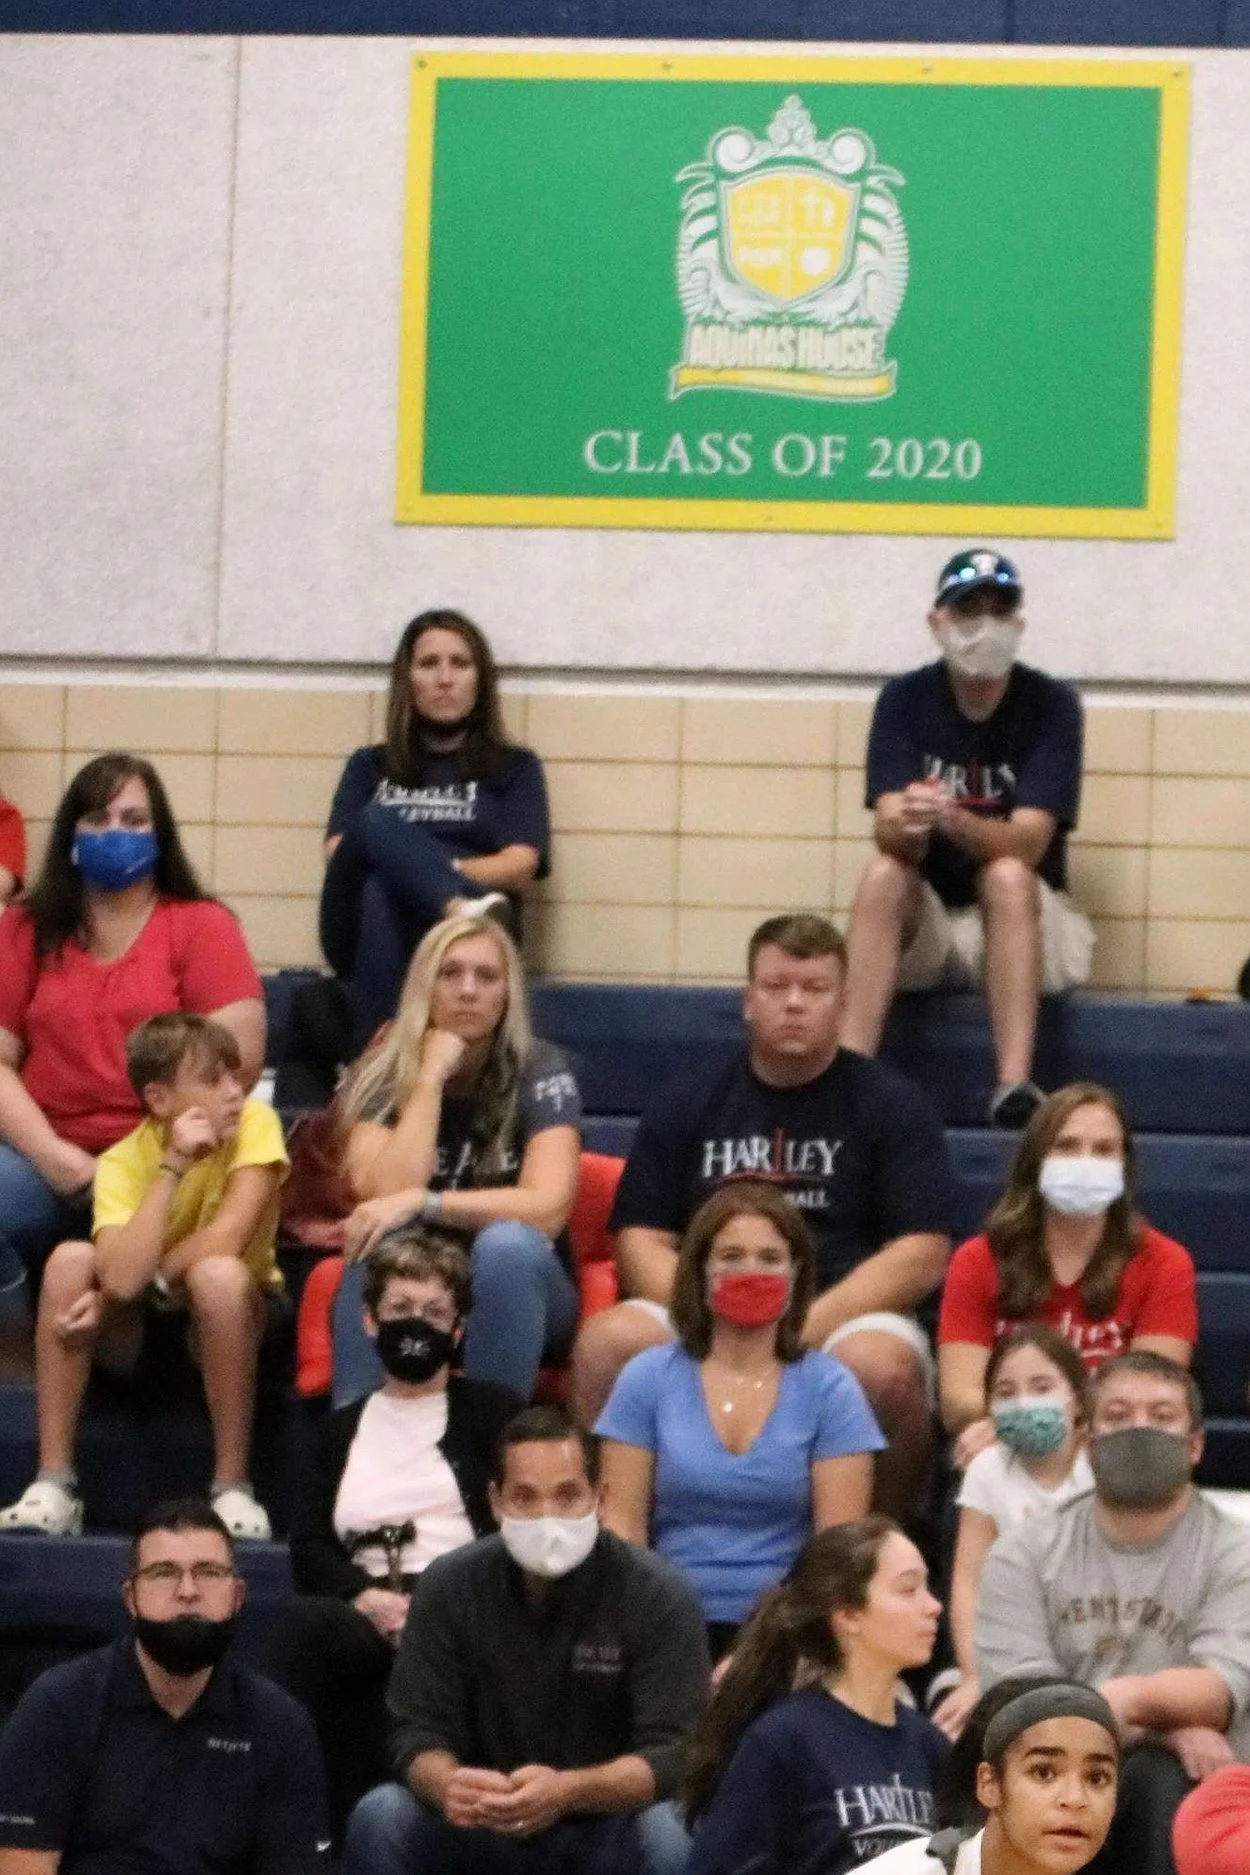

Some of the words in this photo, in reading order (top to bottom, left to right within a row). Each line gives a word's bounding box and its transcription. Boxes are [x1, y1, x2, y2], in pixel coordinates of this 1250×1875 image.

[582, 429, 752, 475] CLASS
[772, 433, 847, 478] OF
[866, 437, 983, 481] 2020
[702, 1128, 845, 1178] HARTLEY
[834, 1772, 934, 1827] HARTLE
